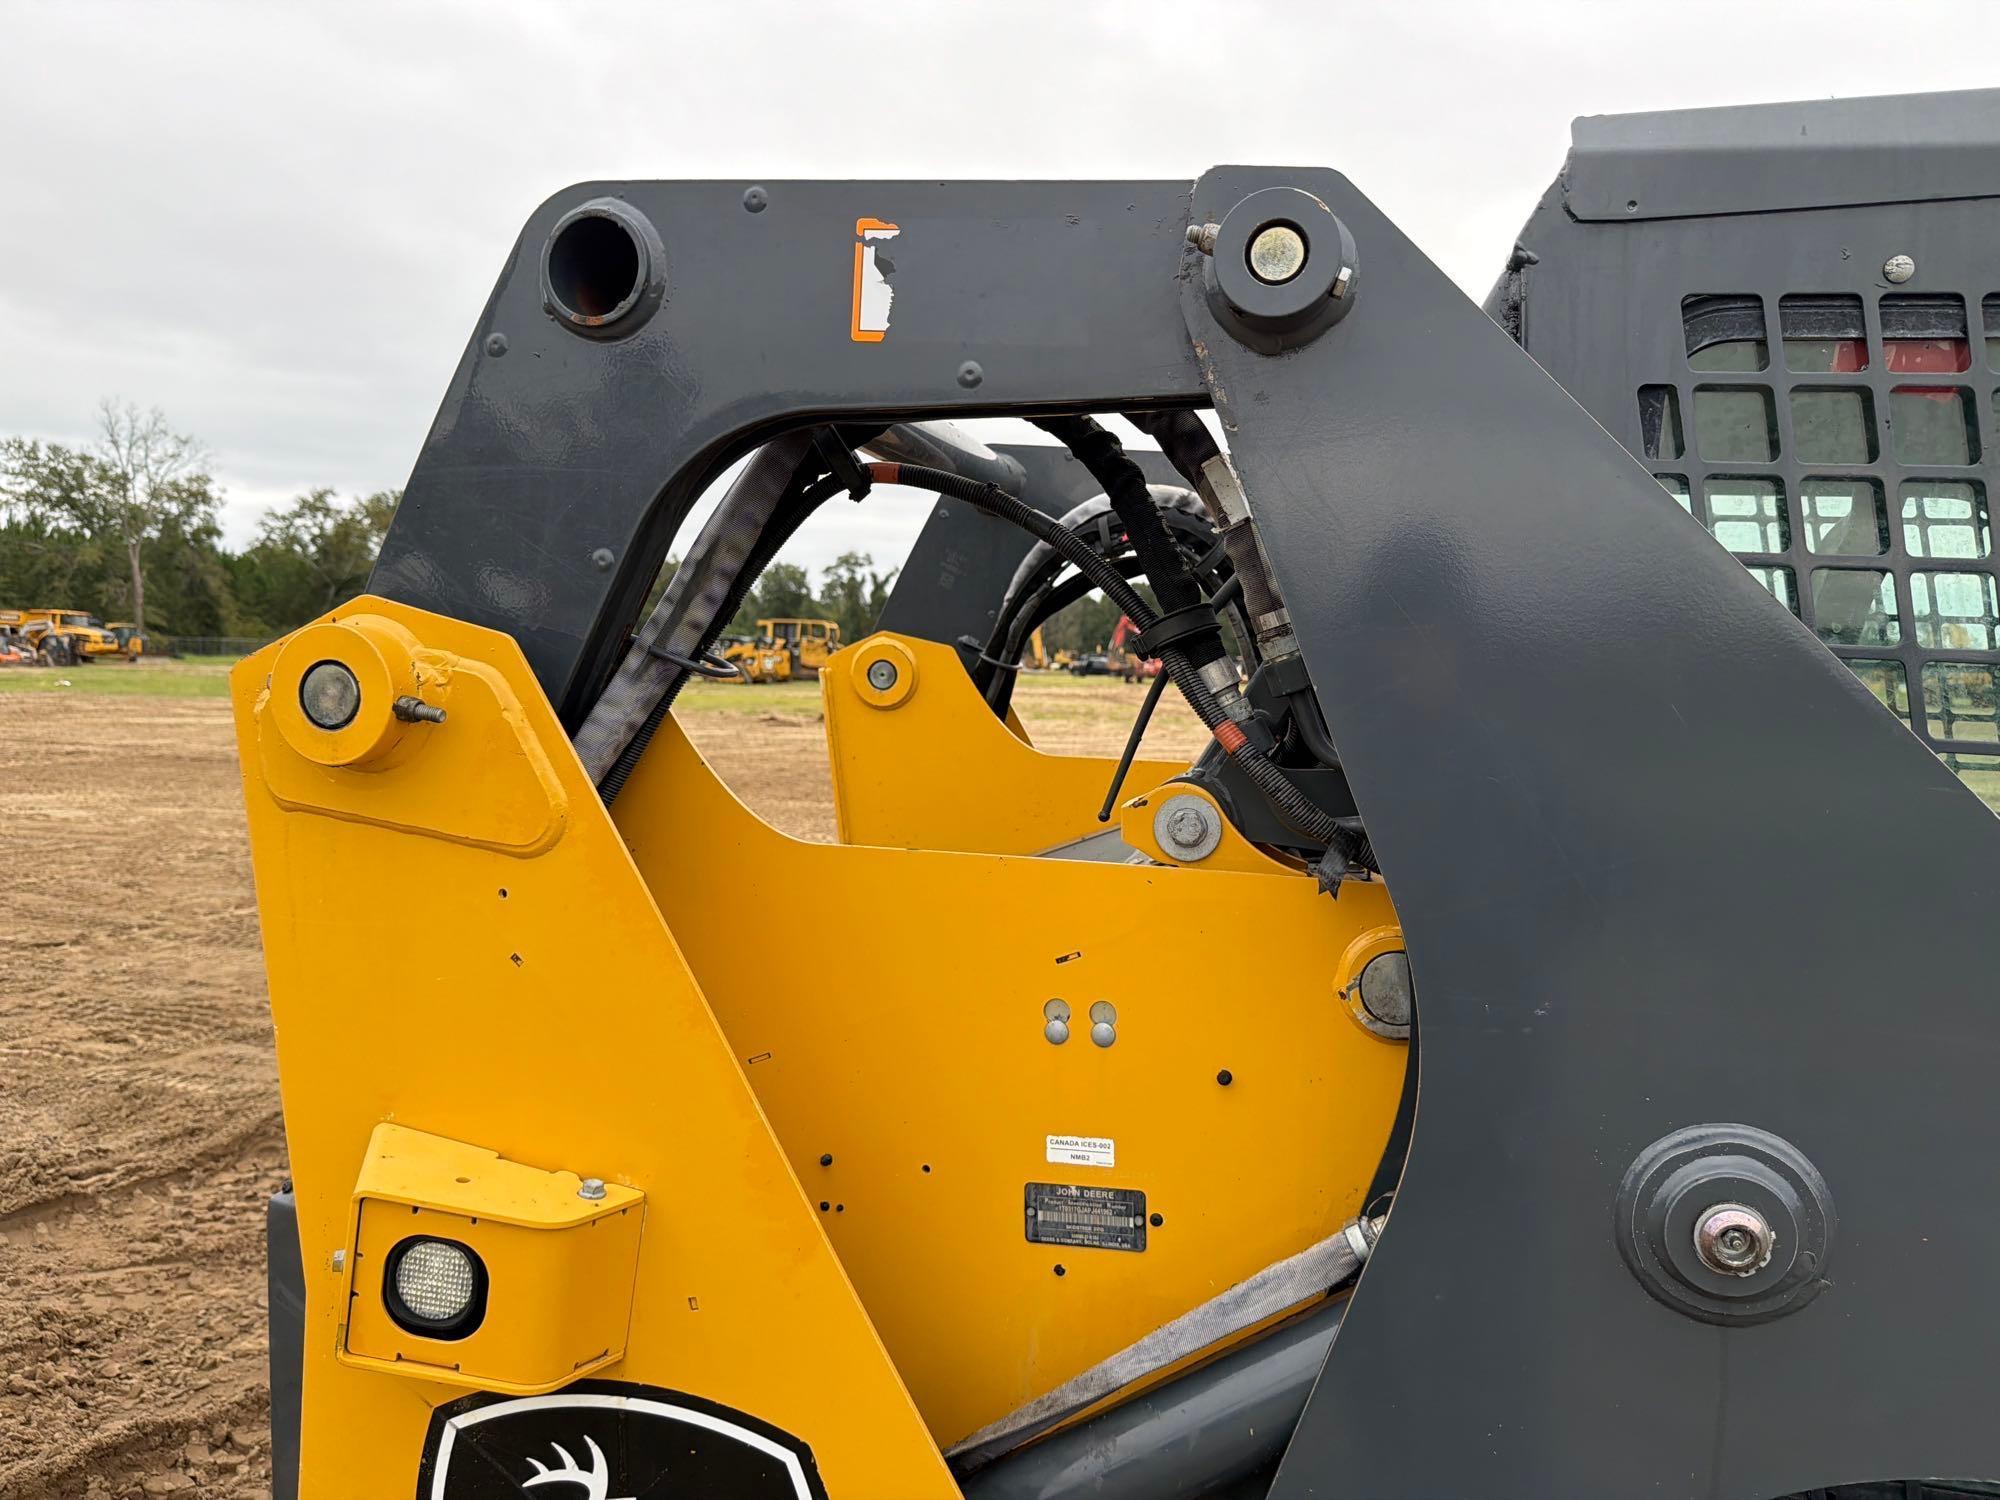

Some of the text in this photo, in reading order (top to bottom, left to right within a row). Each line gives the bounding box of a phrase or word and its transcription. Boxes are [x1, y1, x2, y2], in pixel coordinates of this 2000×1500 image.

[1049, 1138, 1111, 1150] CANADA ICES-002
[1070, 1153, 1090, 1161] NMB2
[1056, 1187, 1114, 1200] JOHN DEERE
